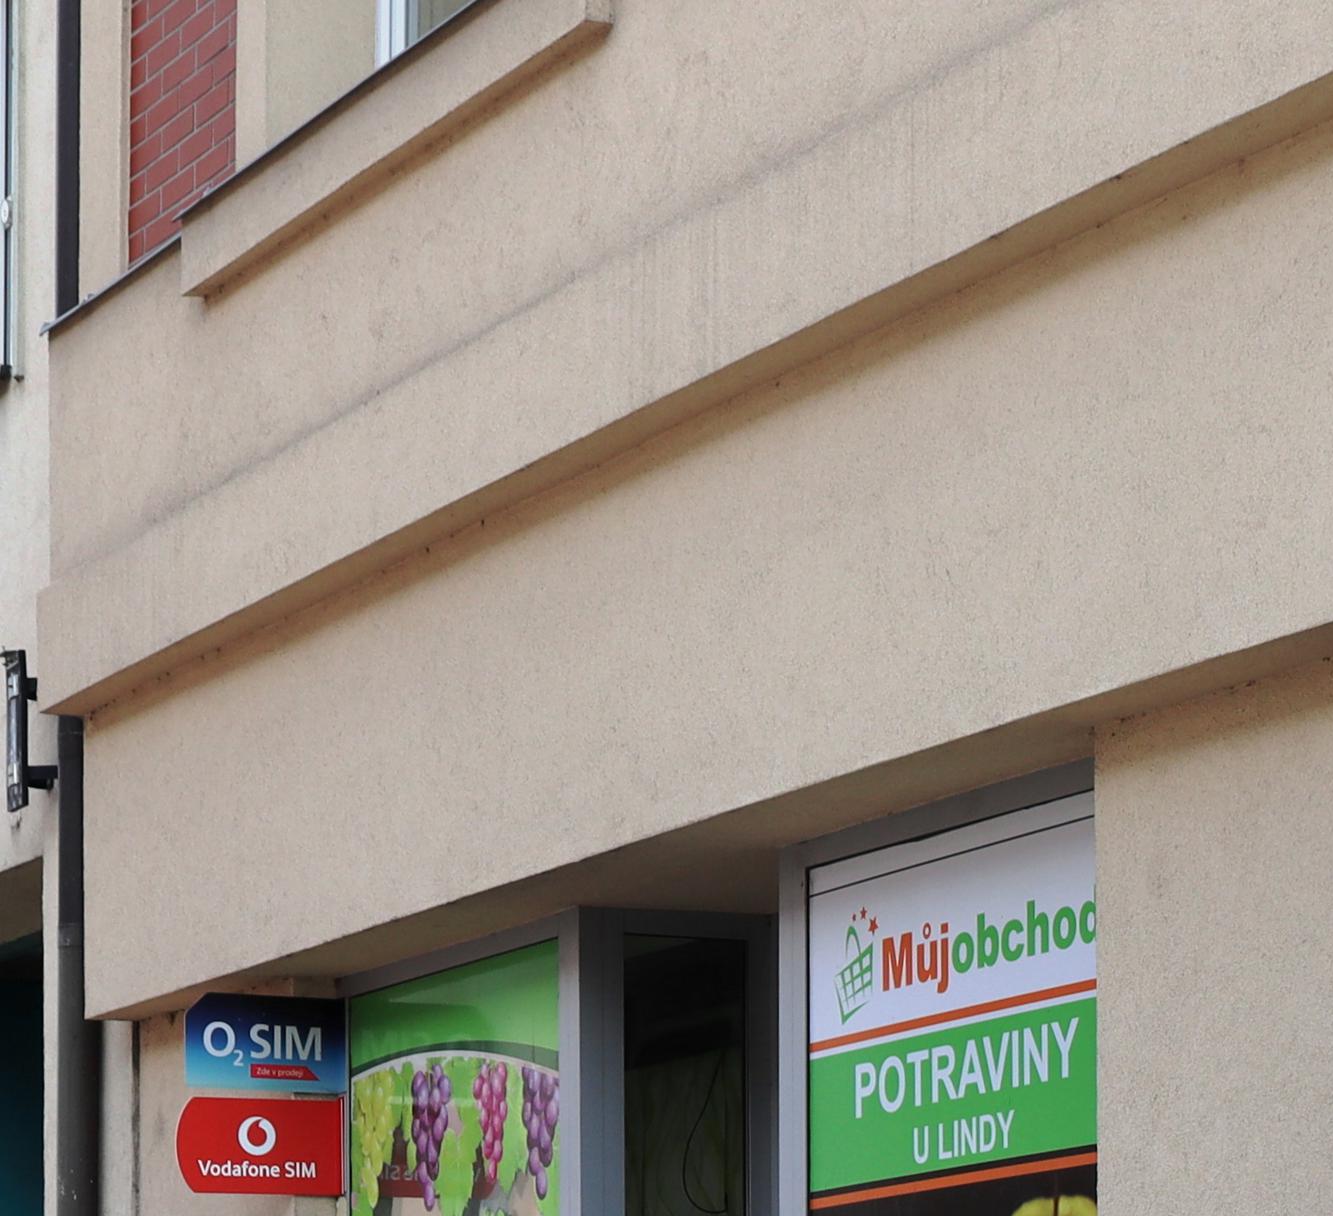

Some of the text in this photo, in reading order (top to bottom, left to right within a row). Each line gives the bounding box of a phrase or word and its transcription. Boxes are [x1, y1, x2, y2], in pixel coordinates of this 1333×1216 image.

[250, 1023, 322, 1062] SIM
[256, 1066, 270, 1076] Zde
[855, 1017, 1079, 1119] POTRAVINY
[913, 1109, 1015, 1164] U LINDY
[198, 1160, 316, 1179] Vodafone SIM
